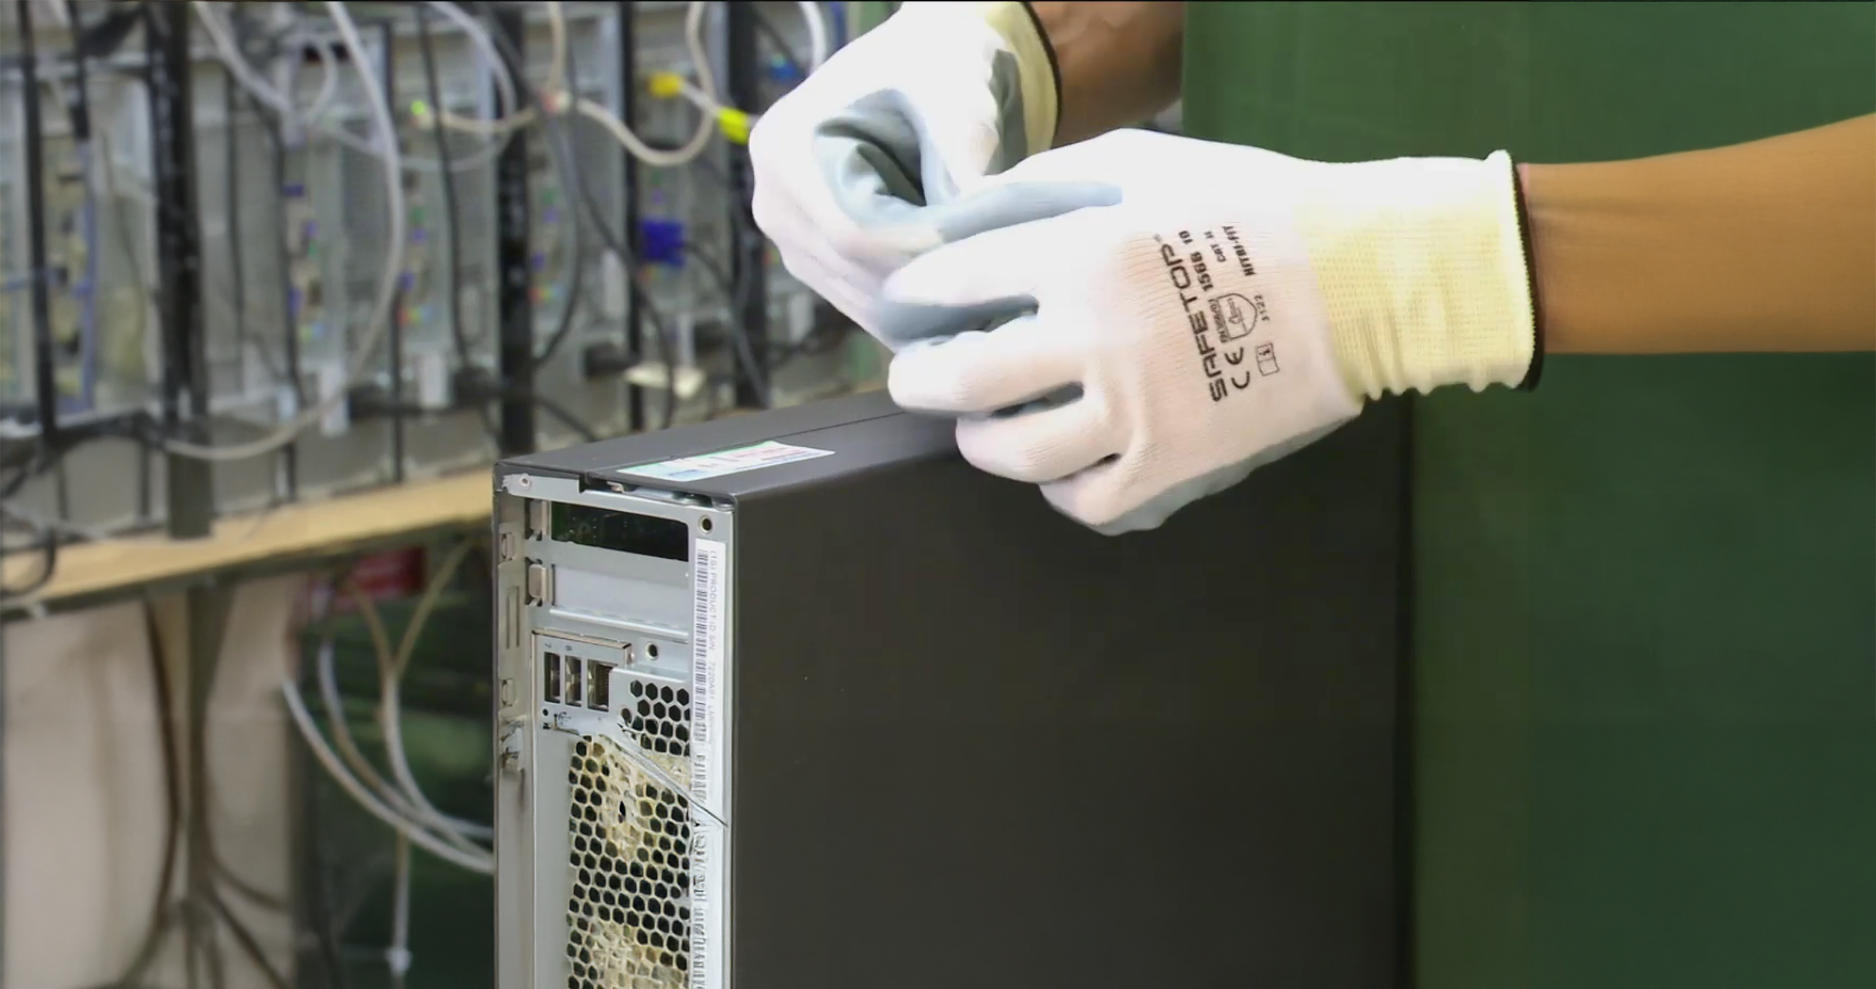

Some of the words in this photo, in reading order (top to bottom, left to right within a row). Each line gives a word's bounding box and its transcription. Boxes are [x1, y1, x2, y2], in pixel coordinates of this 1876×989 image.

[1179, 230, 1193, 244] 10
[1161, 243, 1228, 402] SAFETOP
[709, 572, 717, 619] PRODUCT
